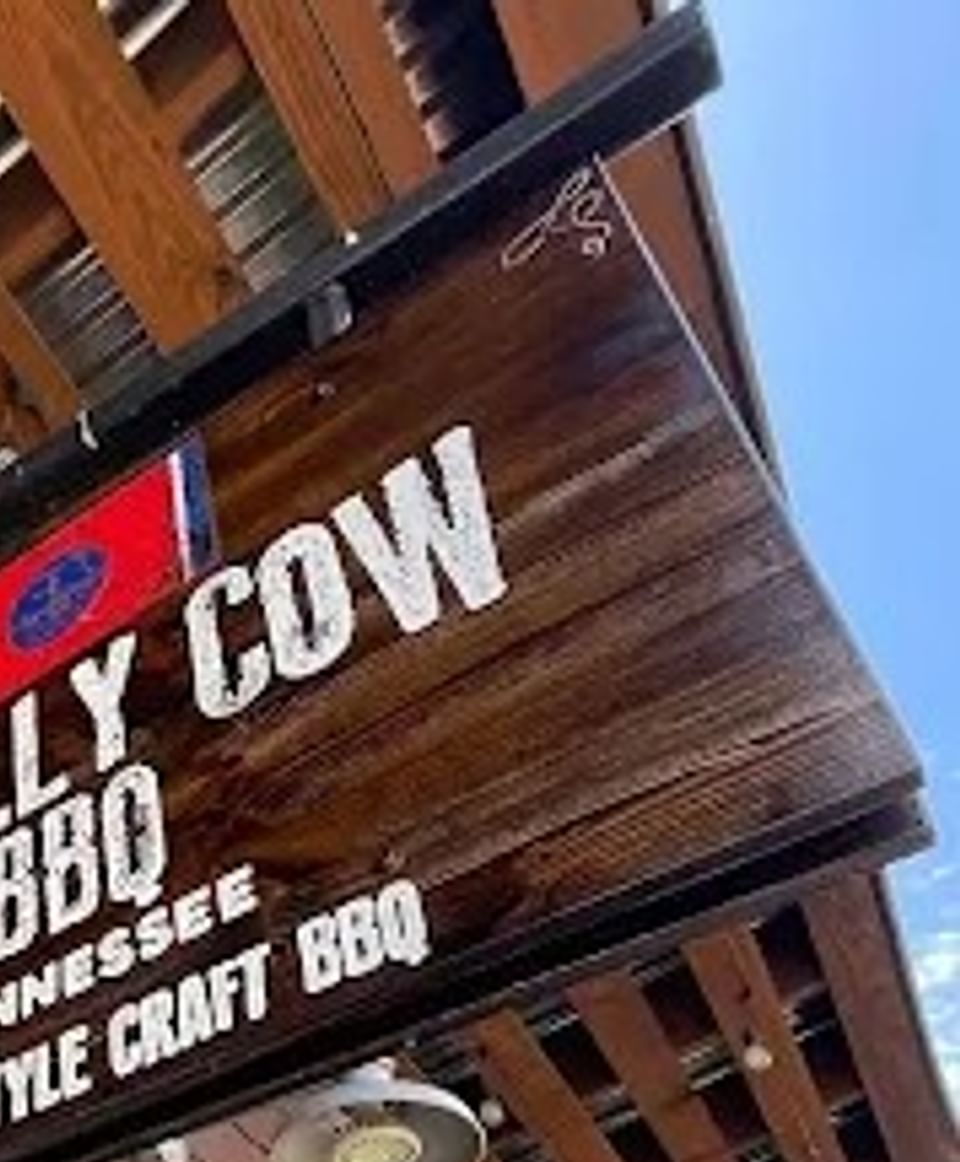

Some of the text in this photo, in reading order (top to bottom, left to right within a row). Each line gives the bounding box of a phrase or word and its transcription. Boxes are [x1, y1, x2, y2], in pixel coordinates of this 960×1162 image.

[184, 426, 508, 718] COW
[107, 943, 271, 1078] CRAFT
[297, 879, 430, 994] BBQ
